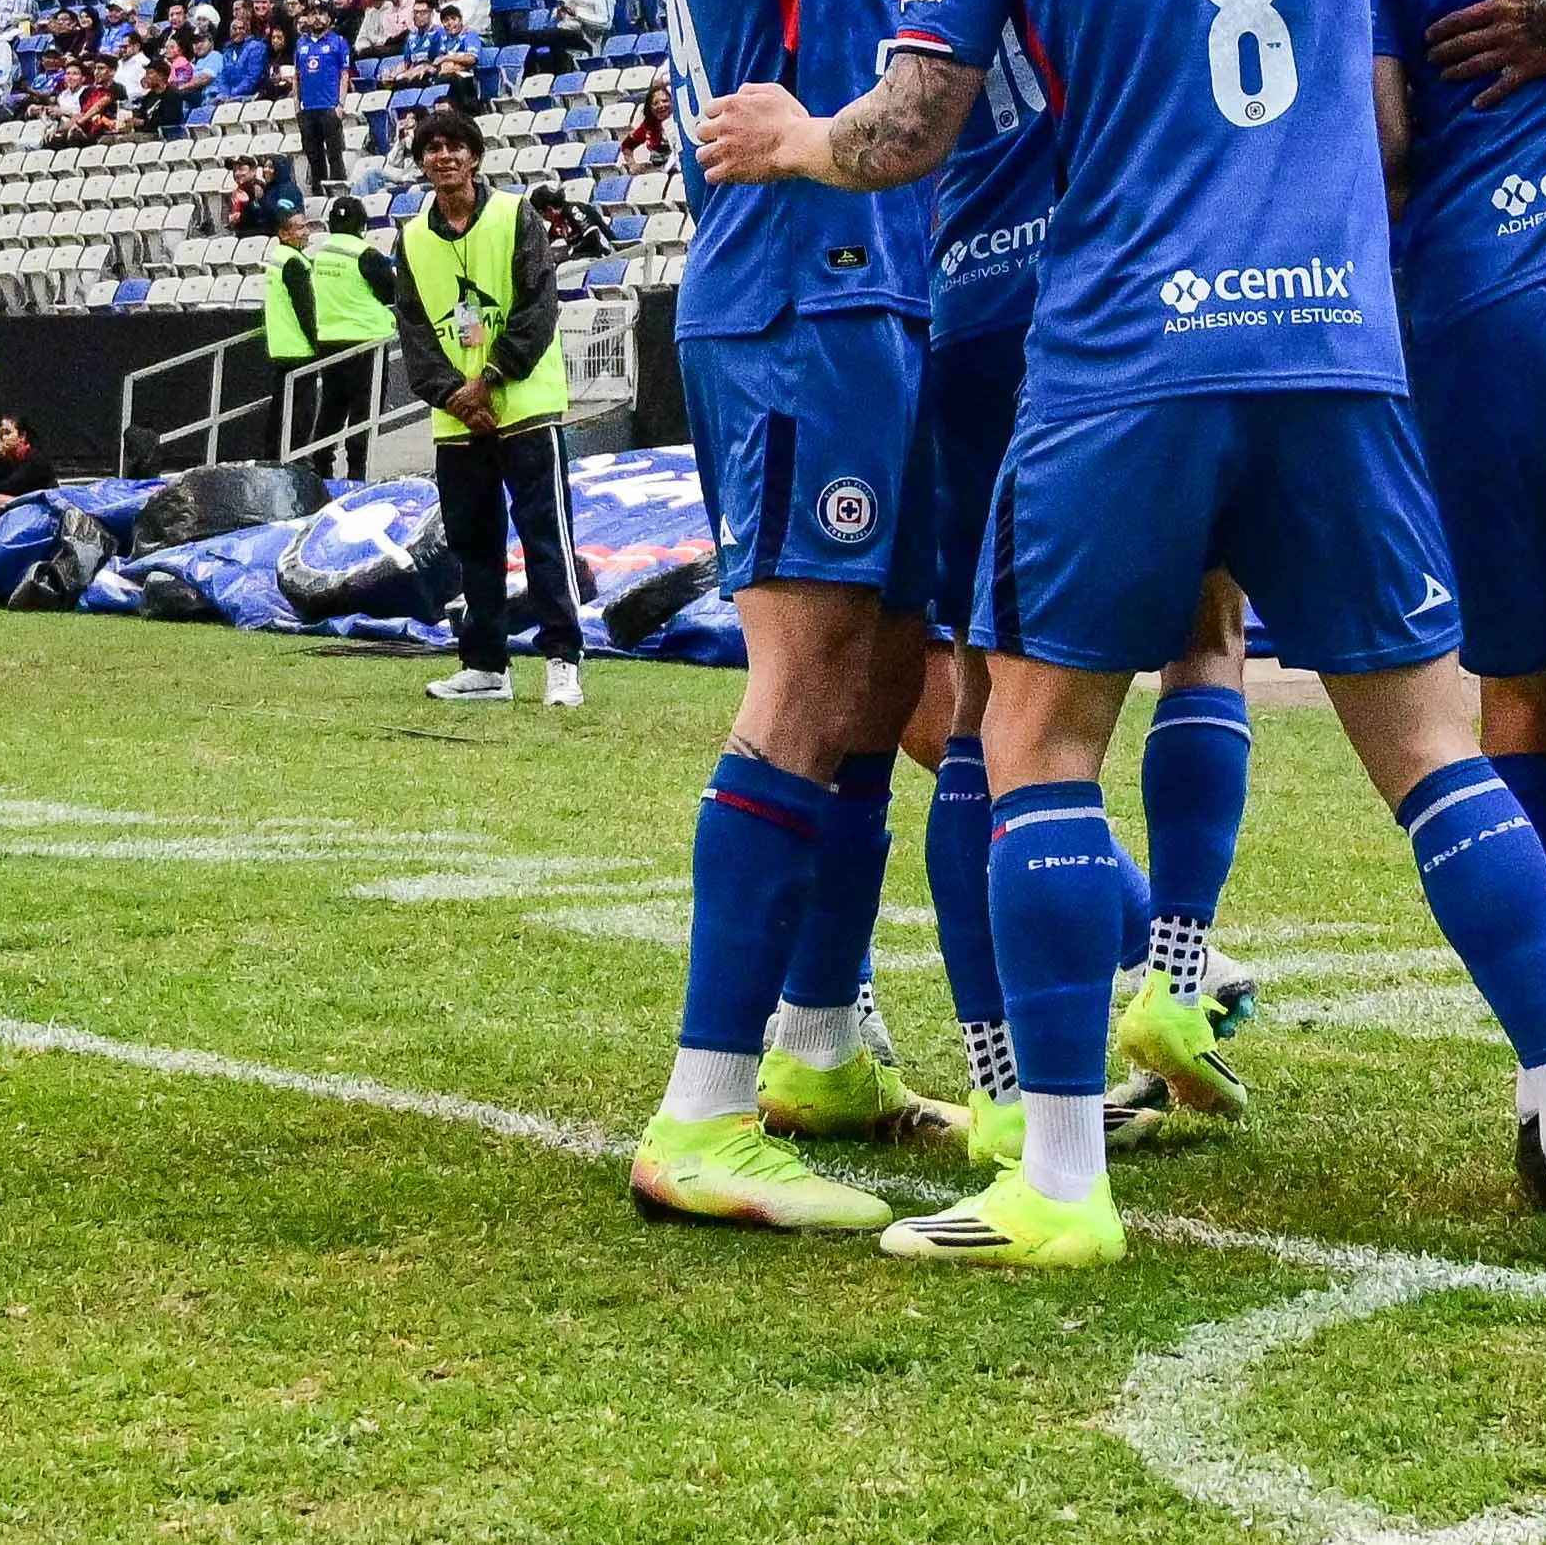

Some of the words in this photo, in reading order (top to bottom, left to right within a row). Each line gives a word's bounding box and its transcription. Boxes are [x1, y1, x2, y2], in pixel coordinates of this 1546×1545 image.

[969, 206, 1055, 260] cemi
[1015, 257, 1024, 269] Y
[1215, 258, 1347, 302] cemix
[1163, 310, 1268, 335] ADHESIVOS
[1273, 310, 1287, 327] Y
[1291, 308, 1363, 327] ESTUCOS
[939, 790, 986, 802] CRUZ
[1423, 837, 1474, 874] CRUZ
[1477, 816, 1532, 842] AZUL
[1028, 855, 1090, 870] CRUZ
